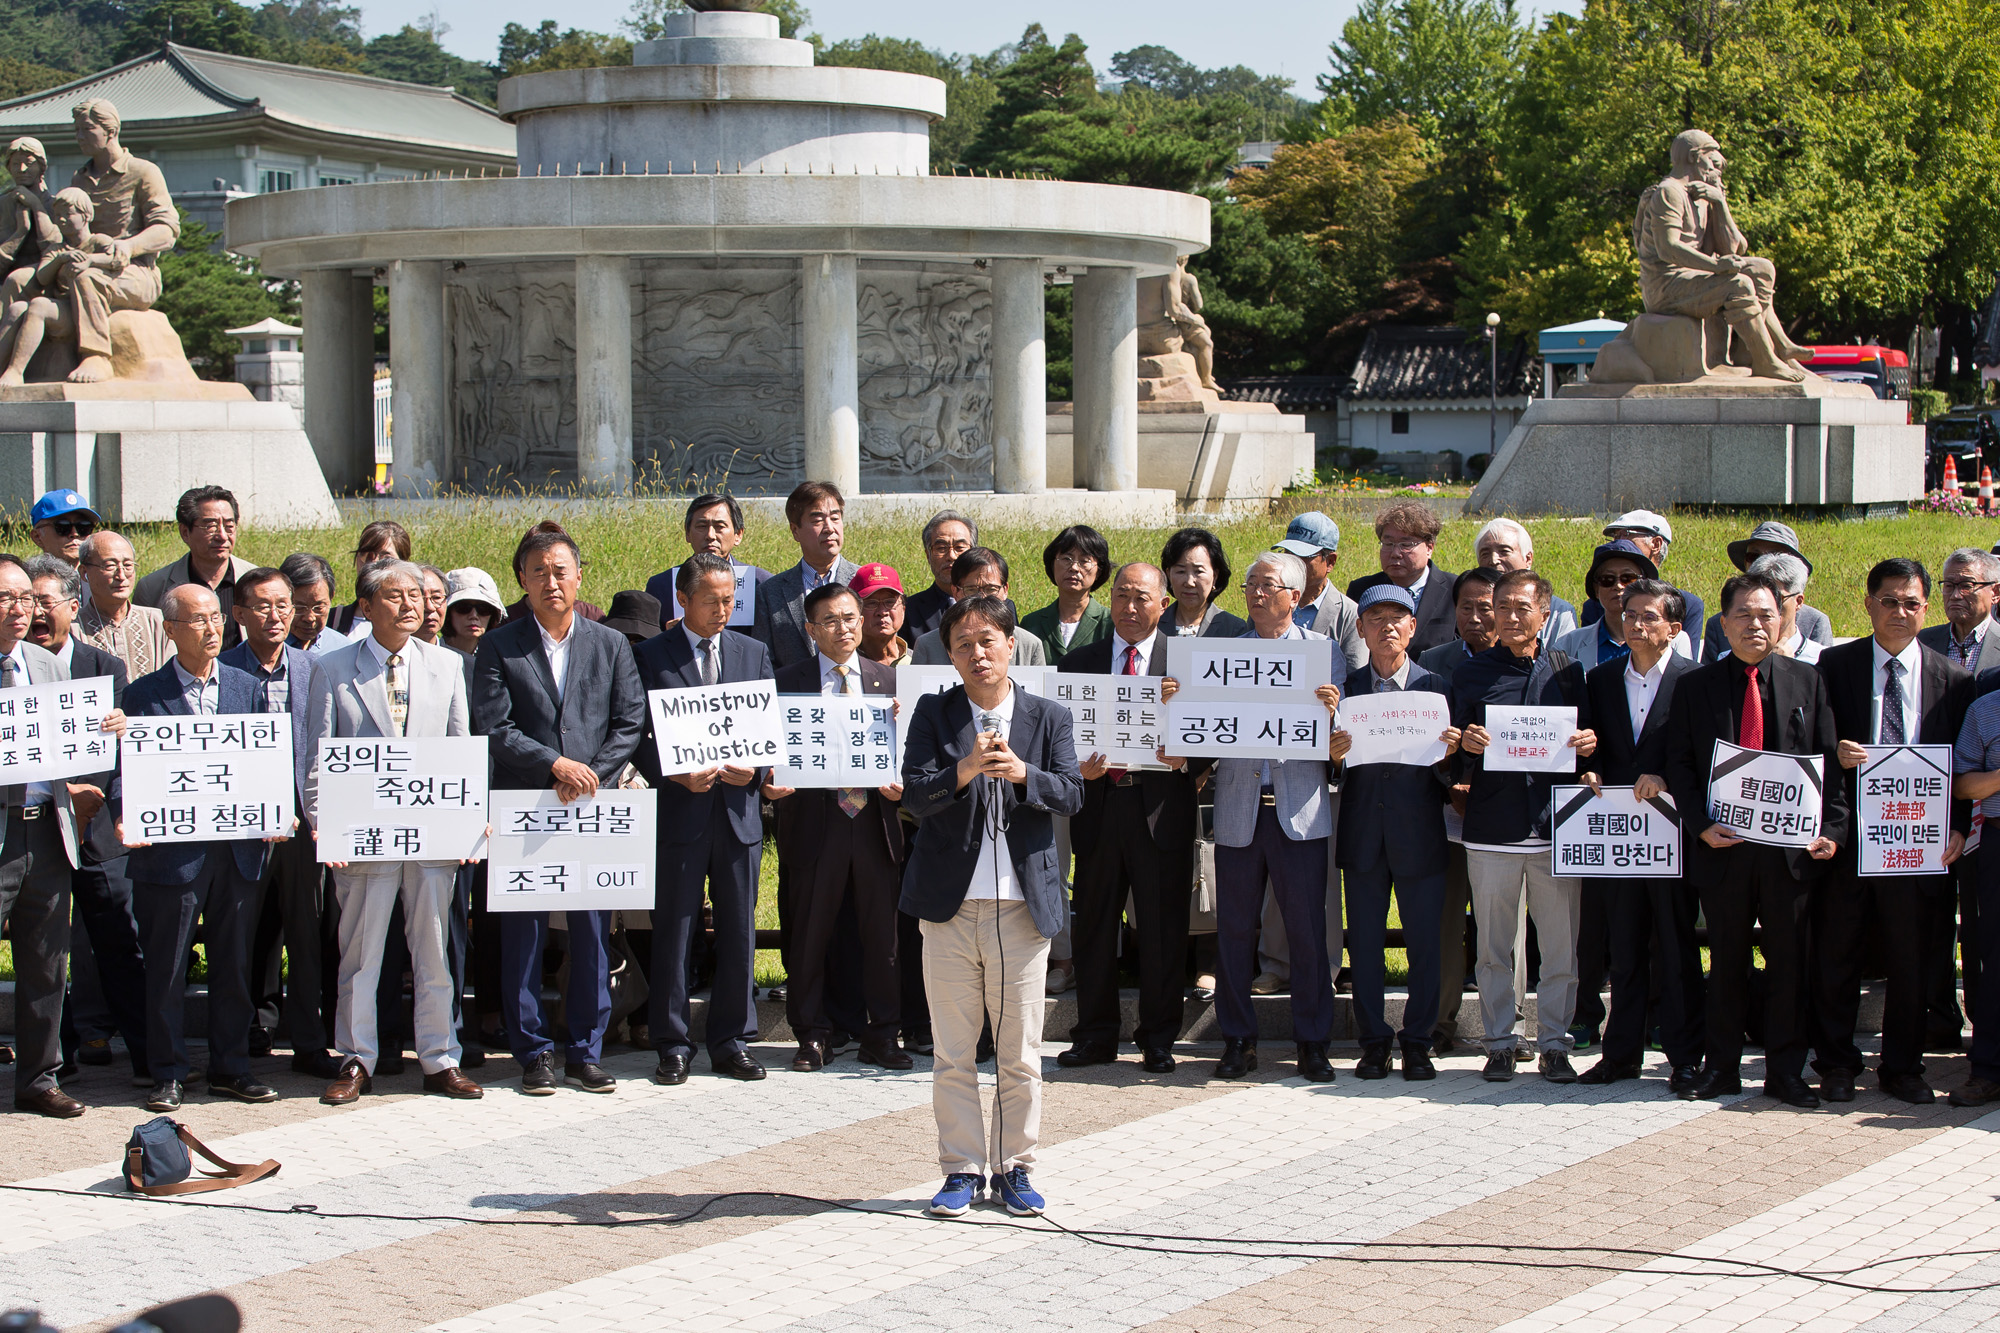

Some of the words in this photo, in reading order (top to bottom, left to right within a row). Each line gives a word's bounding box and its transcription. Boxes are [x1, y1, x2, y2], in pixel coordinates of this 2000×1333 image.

[1202, 657, 1293, 687] 사라진
[661, 691, 771, 718] Ministruy
[787, 708, 825, 723] 온갖
[850, 708, 886, 724] 비리
[1381, 709, 1417, 720] 사회주의
[124, 720, 280, 752] 후안무치한
[708, 716, 734, 736] of
[787, 731, 826, 747] 조국
[851, 731, 888, 746] 장관
[1180, 717, 1239, 744] 공정
[1257, 718, 1318, 747] 사회
[1500, 731, 1518, 741] 아들
[1521, 731, 1556, 741] 재수시킨
[3, 747, 42, 767] 조국
[63, 740, 106, 761] 구속!
[672, 739, 777, 765] Injustice
[1116, 732, 1160, 749] 구속!
[1508, 746, 1548, 757] 나쁜교수
[324, 744, 412, 773] 정의는
[789, 754, 826, 770] 즉각
[168, 764, 233, 793] 조국
[1866, 777, 1909, 797] 조국이
[1914, 777, 1942, 797] 만든
[375, 777, 480, 807] 죽었다.
[140, 806, 196, 838] 임명
[211, 803, 281, 833] 철회!
[511, 805, 635, 834] 조로남불
[1711, 799, 1754, 830] 祖國
[1761, 811, 1817, 837] 망친다
[1881, 801, 1926, 820] 法無部
[354, 827, 421, 856] 謹弔
[1867, 824, 1907, 845] 국민이
[1912, 824, 1940, 843] 만든
[1562, 844, 1604, 866] 祖國
[1612, 843, 1673, 867] 망친다
[1882, 847, 1924, 868] 法務部
[506, 865, 569, 892] 조국
[596, 871, 638, 888] OUT
